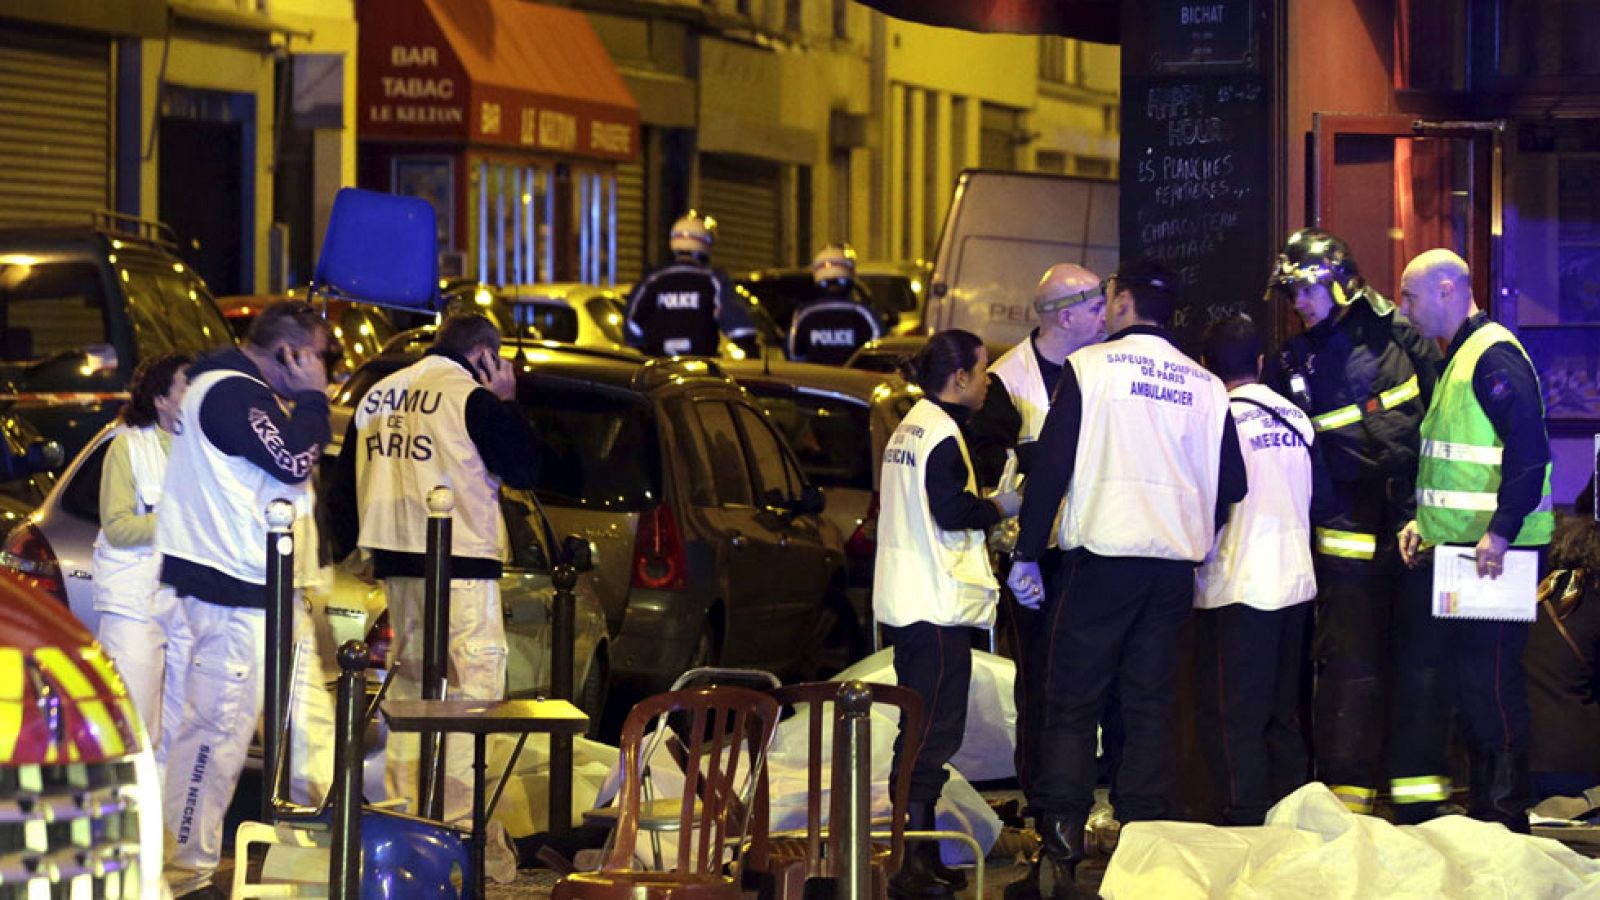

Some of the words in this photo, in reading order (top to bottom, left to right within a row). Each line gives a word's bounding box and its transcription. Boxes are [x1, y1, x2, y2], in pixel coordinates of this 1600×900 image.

[1181, 5, 1224, 24] BICHAT
[391, 46, 438, 66] BAR
[382, 77, 454, 98] TABAC
[370, 105, 391, 122] LE
[480, 102, 501, 134] BAR
[520, 107, 535, 145] LE
[1163, 154, 1234, 181] PLANCHES
[656, 291, 700, 310] POLICE
[810, 328, 855, 347] POLICE
[1106, 353, 1155, 368] SAPEURS
[1141, 366, 1155, 378] DE
[1157, 370, 1185, 385] PARIS
[364, 387, 443, 415] SAMU
[1130, 381, 1193, 407] AMBULANCIER
[386, 415, 404, 429] DE
[365, 431, 432, 461] PARIS
[190, 744, 210, 783] SMUR
[177, 786, 199, 845] NECKER
